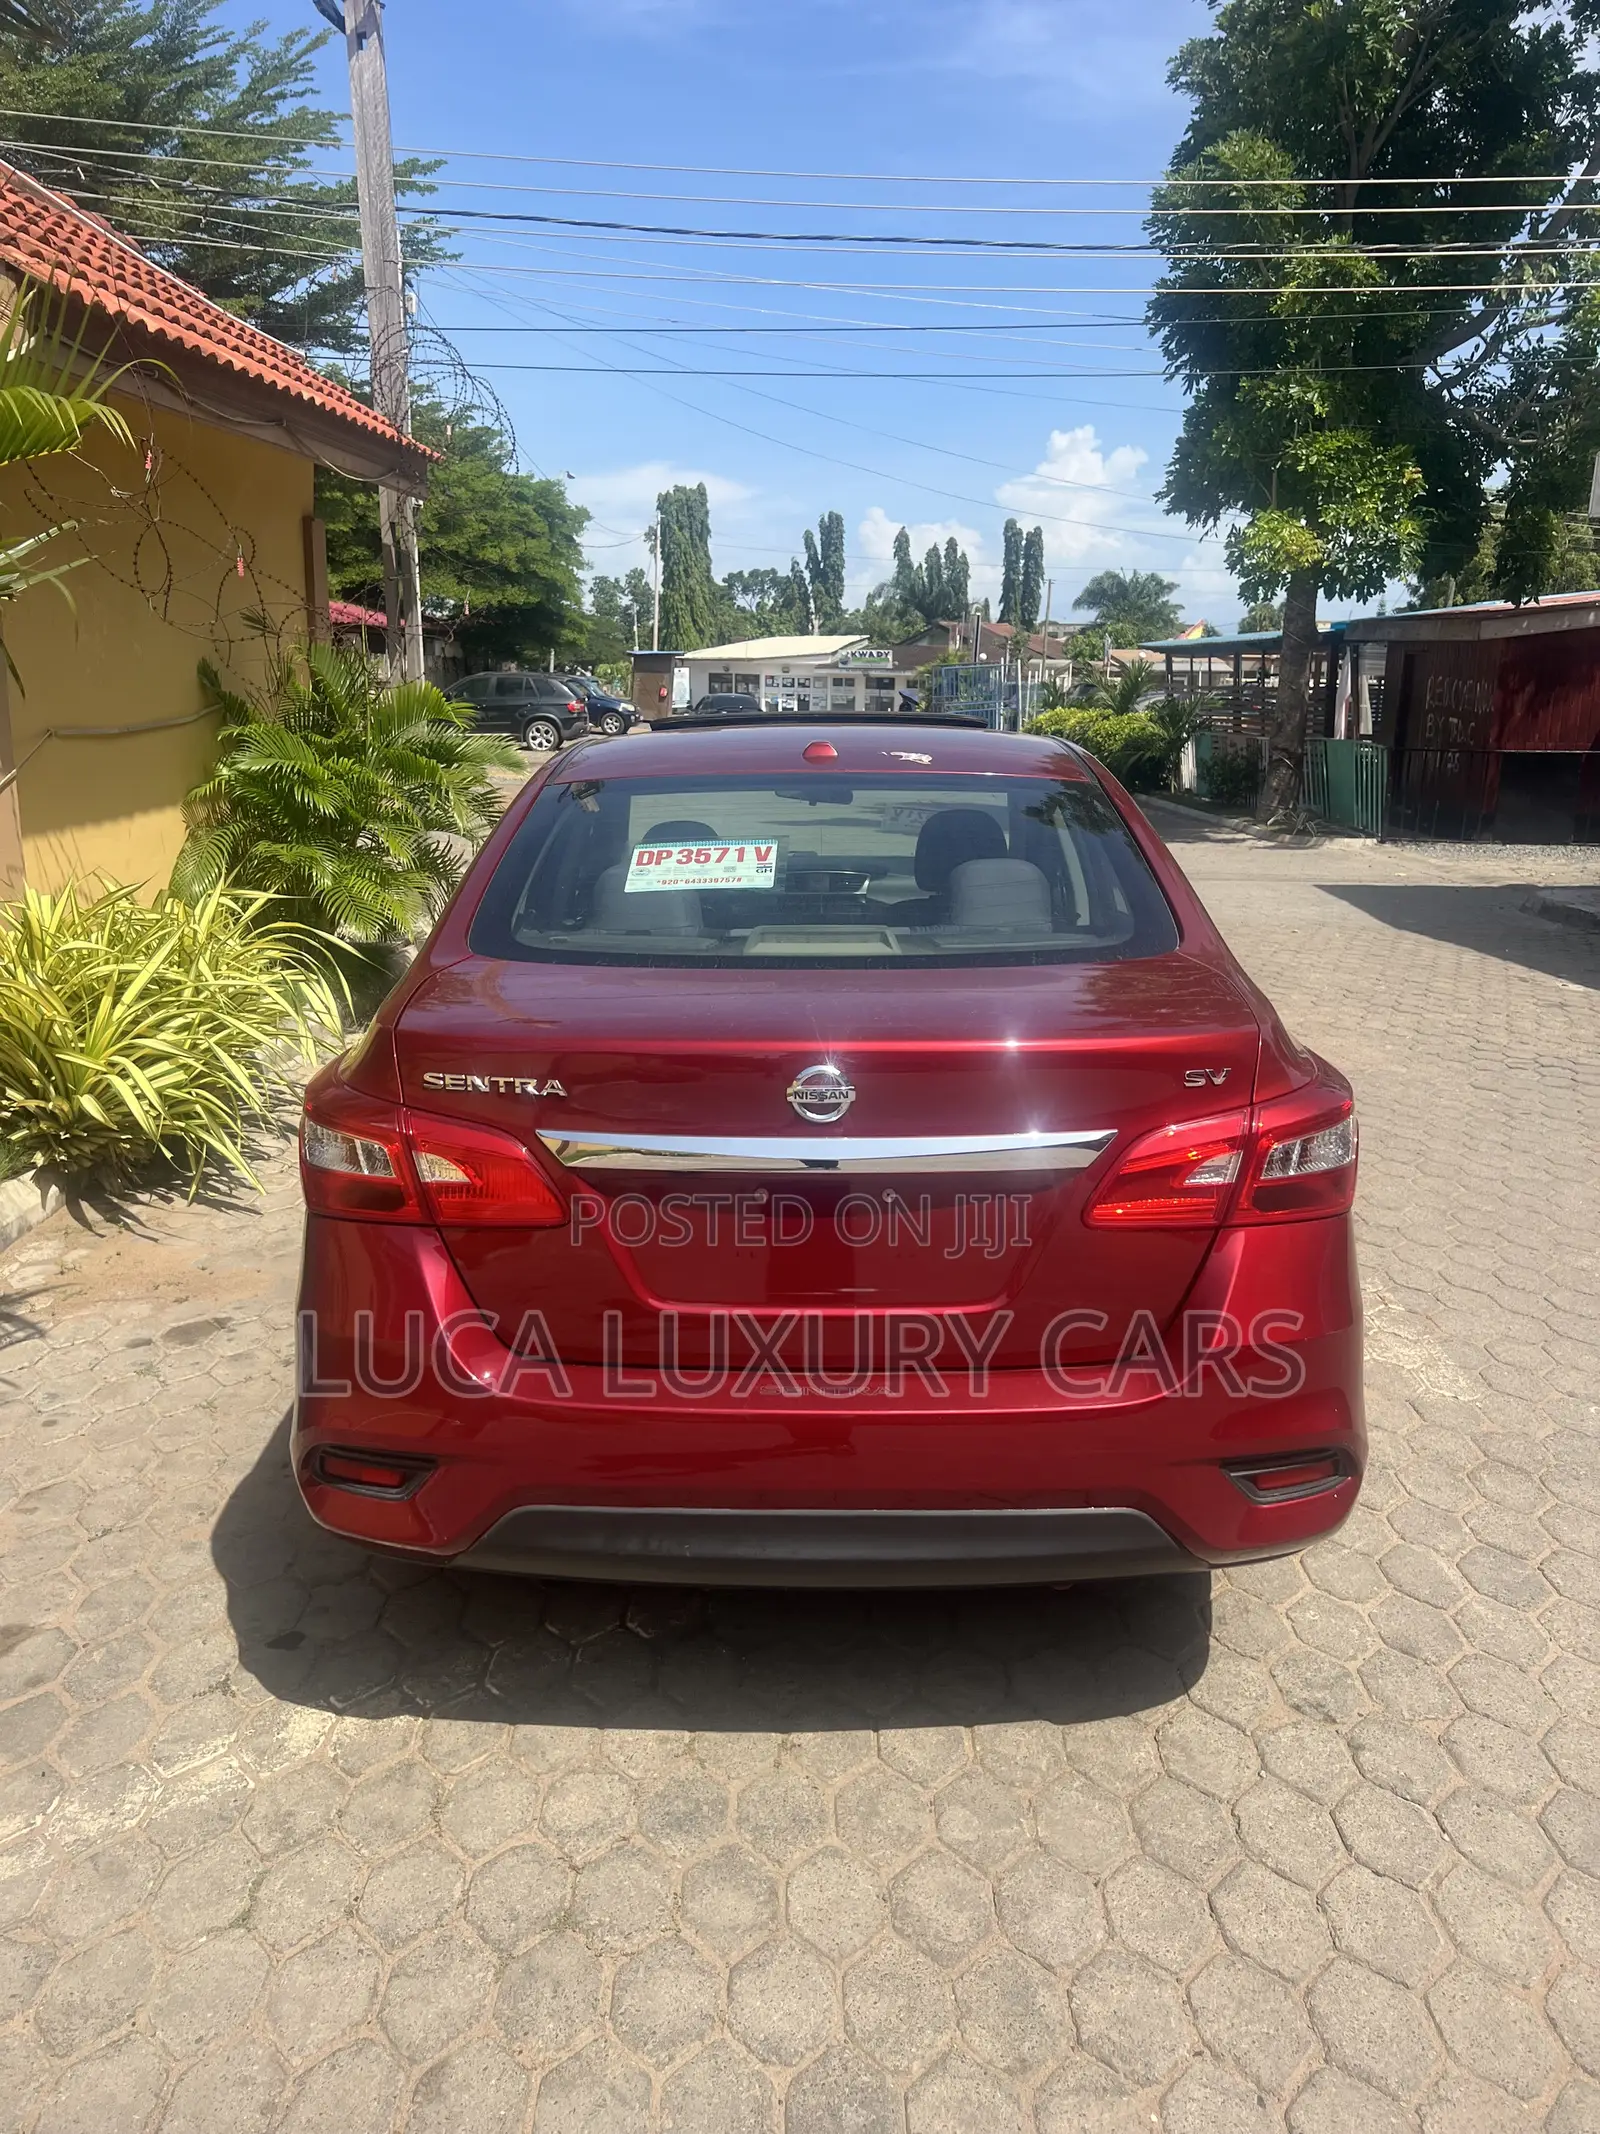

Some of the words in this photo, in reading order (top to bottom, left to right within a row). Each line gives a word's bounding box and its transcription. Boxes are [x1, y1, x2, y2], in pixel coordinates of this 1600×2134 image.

[635, 849, 673, 866] DP
[676, 848, 745, 865] 3571
[754, 846, 773, 862] V
[422, 1072, 568, 1097] SENTRA
[1183, 1067, 1231, 1087] SV
[794, 1091, 849, 1101] NISSAN
